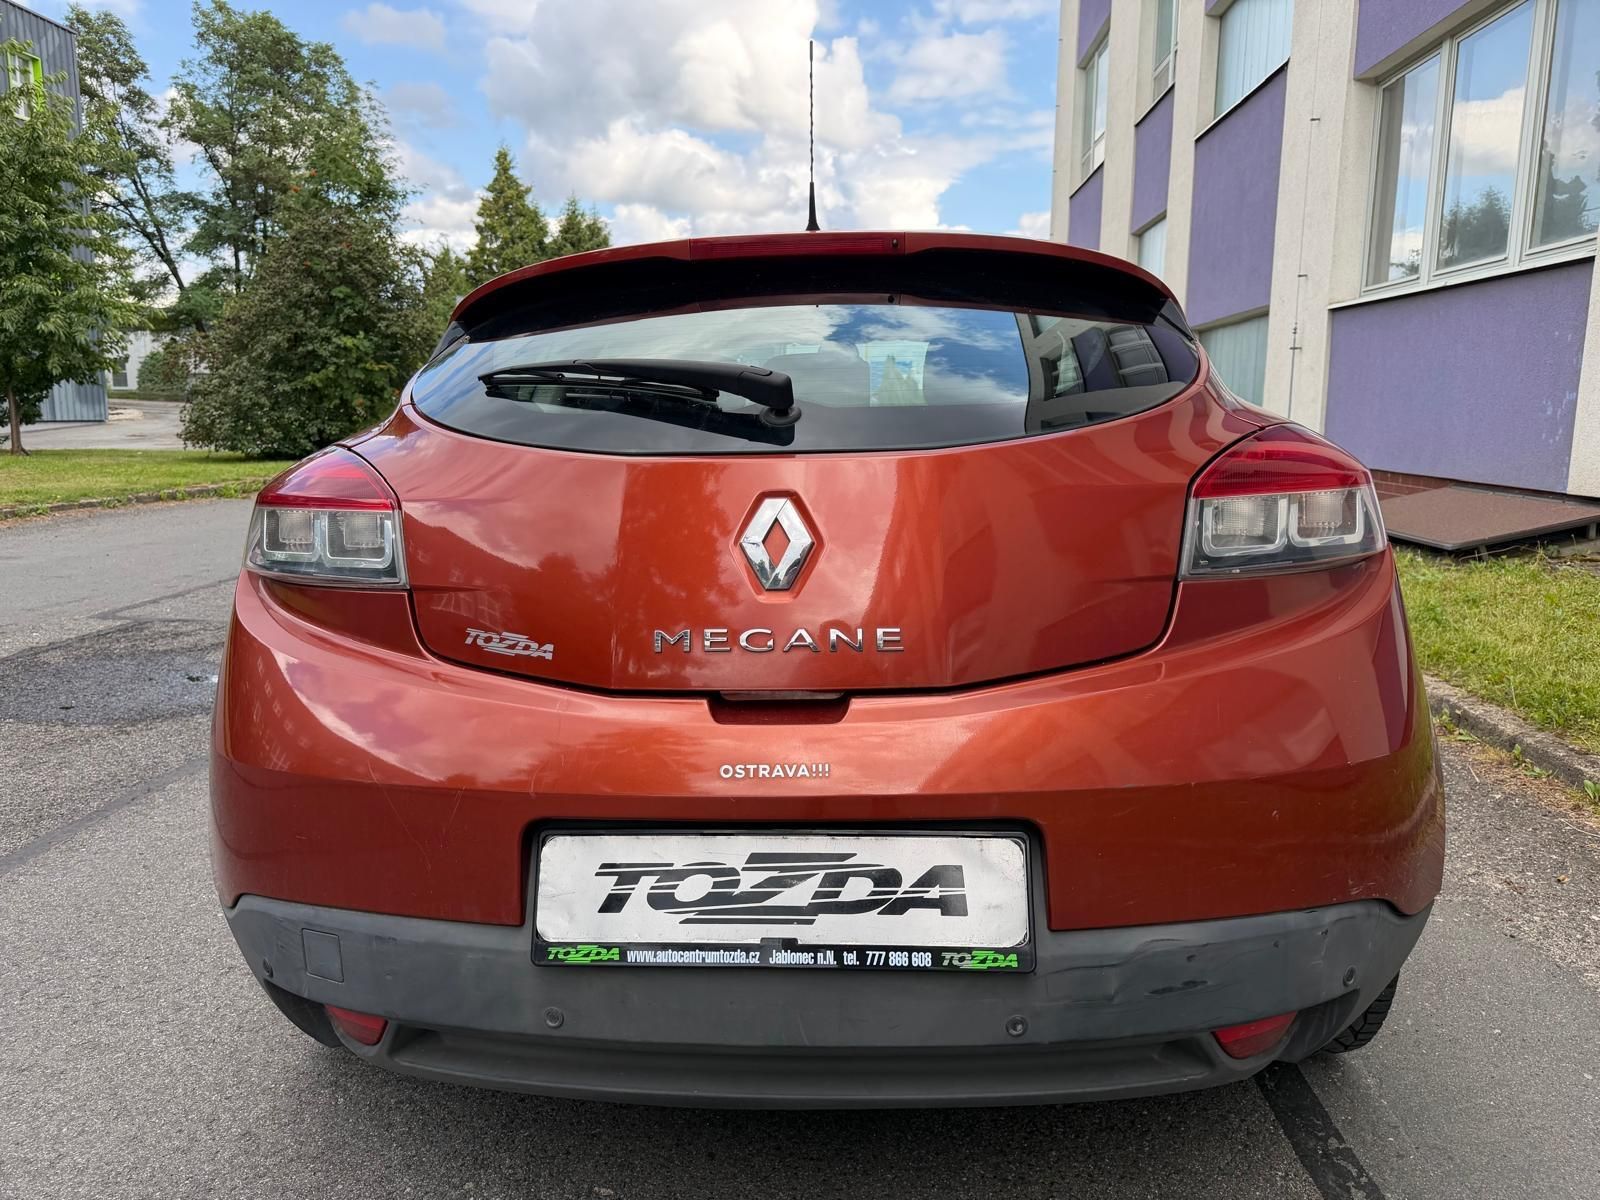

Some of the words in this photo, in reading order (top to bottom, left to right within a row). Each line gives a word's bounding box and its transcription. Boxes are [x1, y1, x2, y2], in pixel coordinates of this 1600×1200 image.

[464, 627, 555, 661] TOZDA
[653, 627, 905, 653] MEGANE
[719, 763, 831, 779] OSTRAVA!!!
[595, 852, 968, 926] TOZDA
[547, 944, 620, 964] TOZDA
[626, 949, 760, 964] www.autocentrumtozda.cz
[769, 950, 814, 965] Jablonec
[816, 951, 837, 966] n.N.
[842, 951, 860, 966] tel.
[865, 951, 886, 966] 777
[911, 952, 932, 968] 608
[940, 950, 1019, 970] TOZDA
